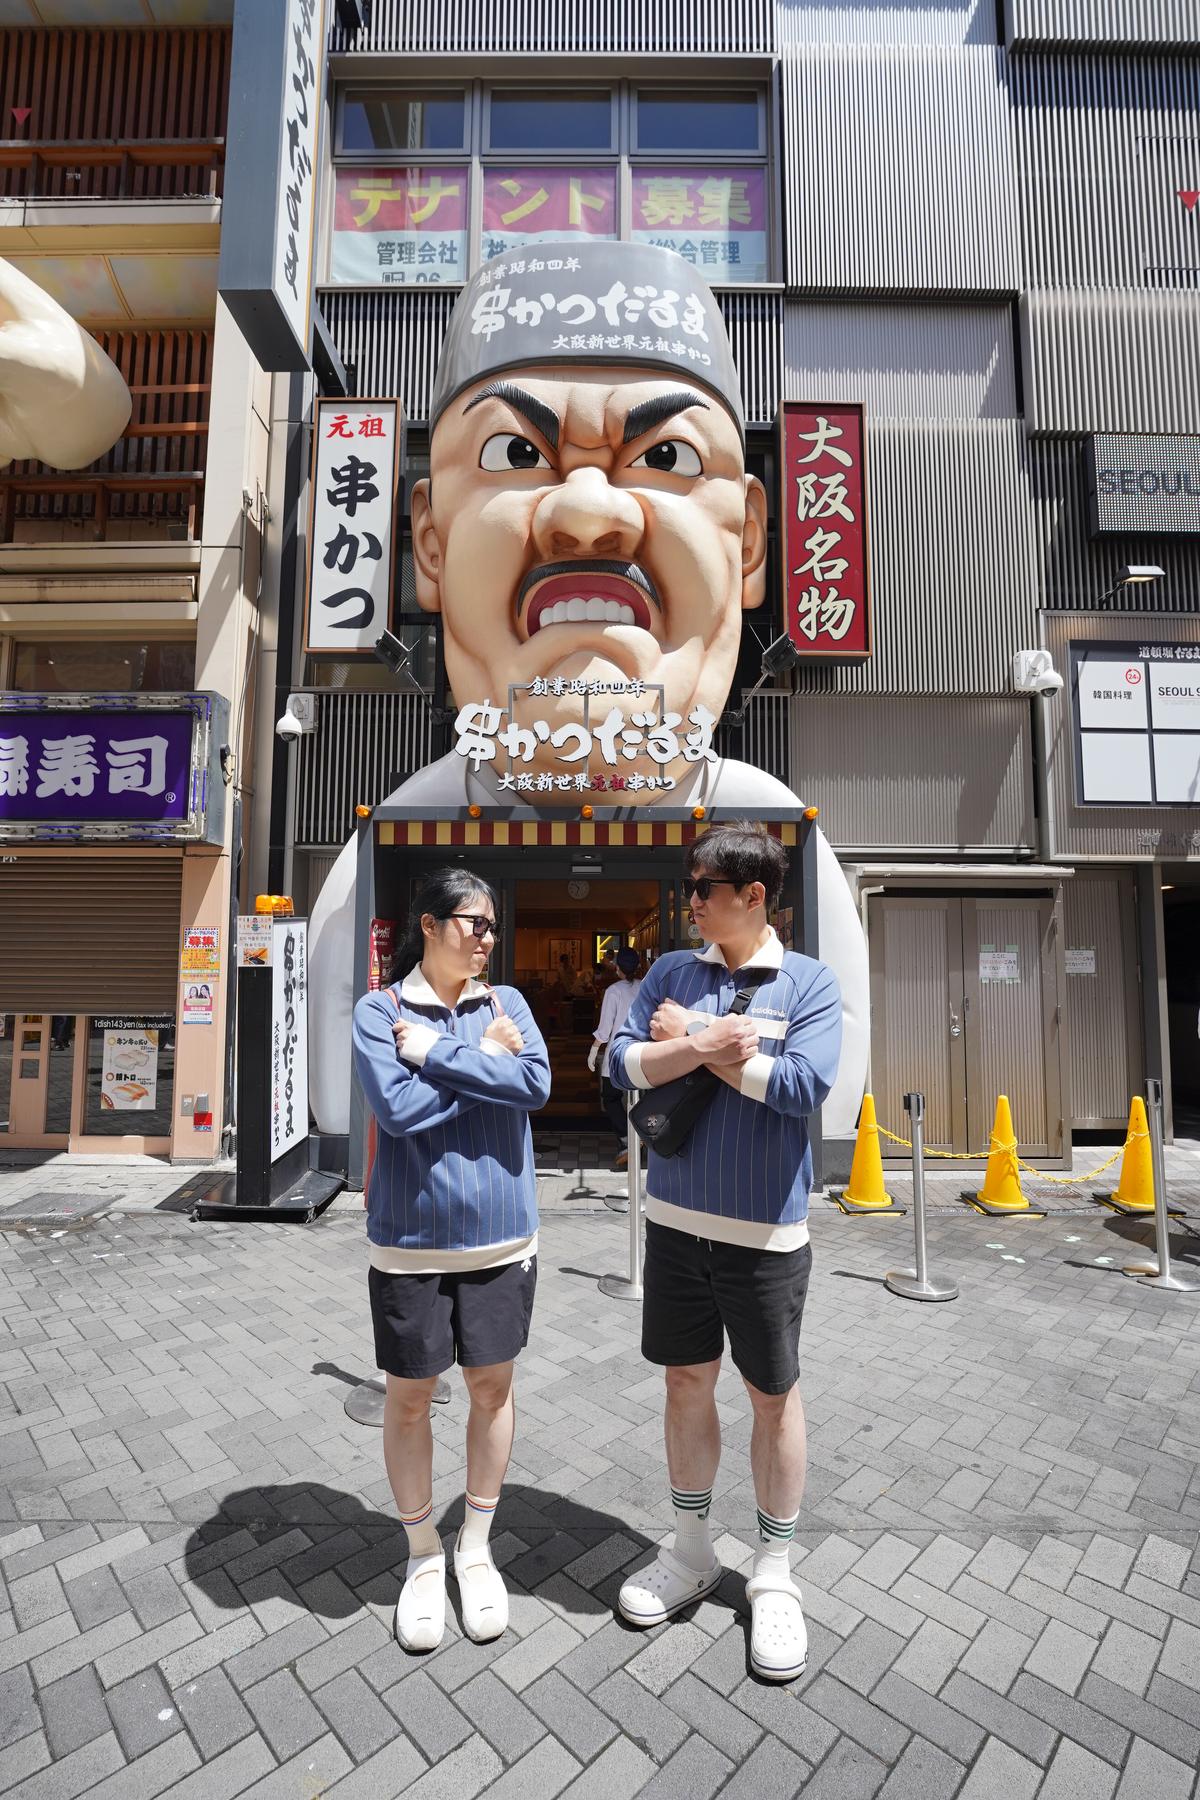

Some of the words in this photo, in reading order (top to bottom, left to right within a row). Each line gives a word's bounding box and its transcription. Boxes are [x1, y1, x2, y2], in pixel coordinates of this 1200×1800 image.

[376, 240, 458, 265] 管理会社
[478, 257, 582, 288] 創業昭和四年
[471, 281, 710, 343] 串かつだるま
[551, 334, 711, 366] 大阪新世界元祖串かつ
[326, 414, 387, 439] 元祖
[1099, 470, 1200, 495] SEOUL
[793, 416, 855, 641] 大阪名物
[319, 455, 383, 629] 串かつ
[528, 676, 647, 698] 創業昭和四年
[1093, 690, 1133, 700] 韓国料理
[1158, 687, 1194, 697] SEOUL
[454, 698, 718, 772] 串かつだるま
[496, 772, 677, 792] 大阪新世界元祖串かつ
[751, 1007, 777, 1016] adidas
